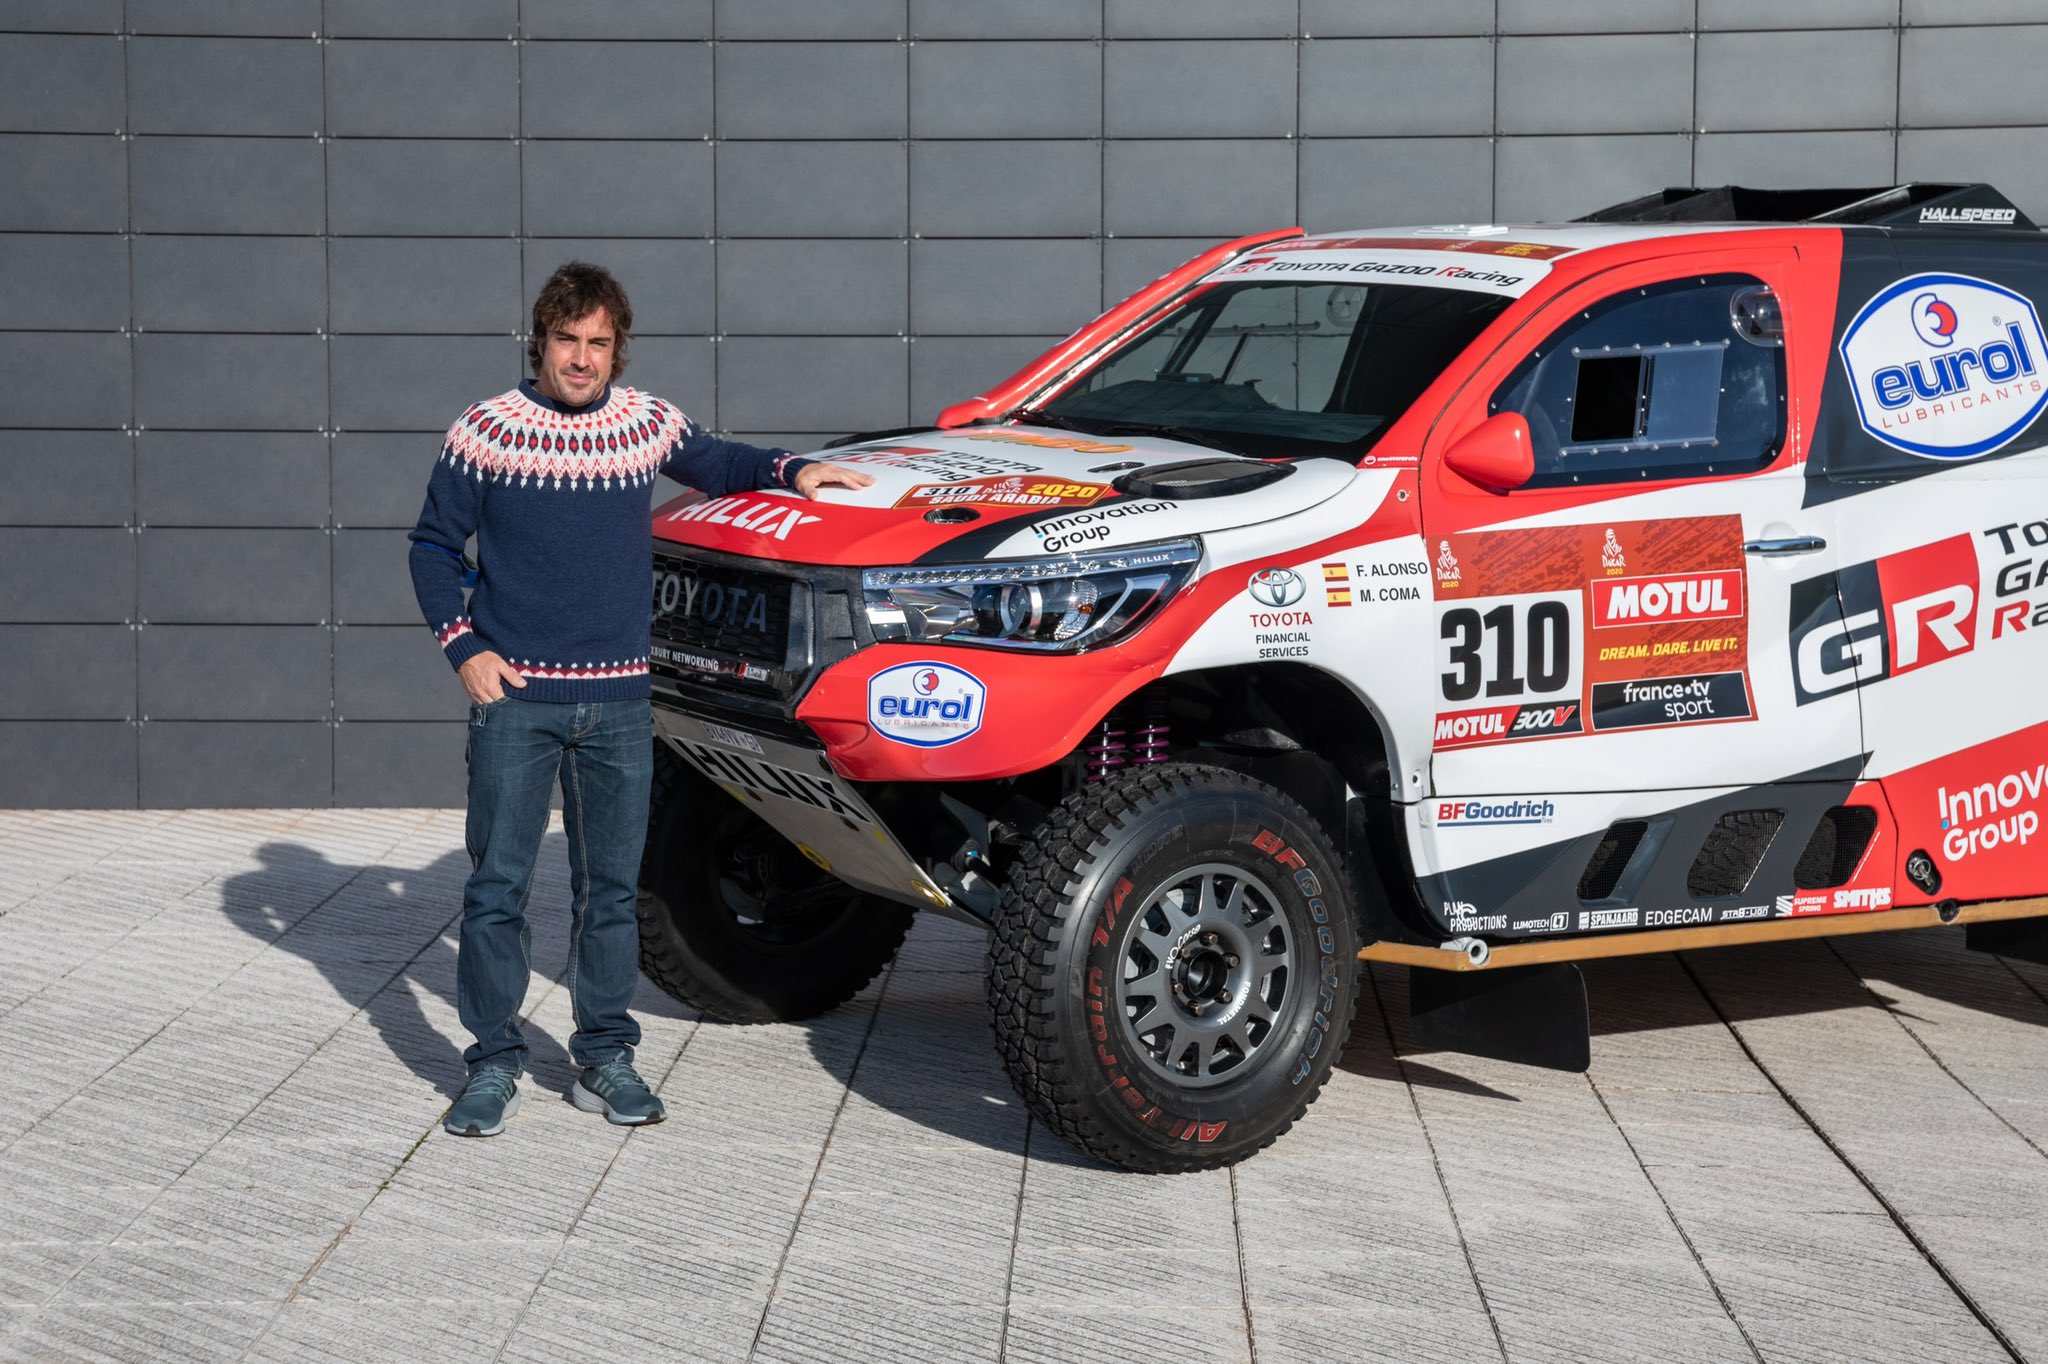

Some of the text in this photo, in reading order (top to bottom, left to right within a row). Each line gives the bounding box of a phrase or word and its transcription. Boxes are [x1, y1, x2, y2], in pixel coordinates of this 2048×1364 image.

[1919, 207, 2016, 223] HALLSPEED
[1267, 261, 1525, 287] TOYOTA GAZOO Racing
[1872, 321, 2037, 411] eurol
[1882, 380, 2042, 429] LUBRICANTS
[881, 458, 973, 482] Racing
[905, 455, 1005, 475] GAZOO
[937, 450, 1044, 473] TOYOTA
[924, 486, 971, 496] 310
[928, 493, 1061, 505] SAUDI ARABIA
[1026, 484, 1099, 498] 2020
[1029, 501, 1178, 538] Innovation
[1043, 525, 1111, 552] Group
[1132, 553, 1171, 565] HILUX
[1356, 561, 1428, 577] F. ALONSO
[1602, 554, 1626, 568] DAKAR
[1436, 566, 1462, 580] DAKAR
[1606, 567, 1623, 575] 2020
[1360, 586, 1420, 602] M. COMA
[1607, 578, 1729, 620] MOTUL
[1250, 611, 1313, 628] TOYOTA
[1255, 632, 1311, 645] FINANCIAL
[1798, 584, 1974, 694] GR
[1259, 646, 1309, 659] SERVICES
[1440, 600, 1571, 703] 310
[1599, 637, 1738, 661] DREAM. DARE. LIVE IT.
[672, 650, 719, 671] NETWORKING
[878, 693, 974, 721] eurol
[1664, 697, 1714, 722] sport
[1435, 705, 1577, 741] MOTUL 300V
[672, 737, 871, 823] HILUX
[1938, 764, 2048, 829] Innov
[1438, 800, 1555, 820] BFGoodrich
[1943, 810, 2039, 862] Group
[1444, 901, 1463, 916] PLAN
[1794, 896, 1827, 905] SUPREME
[1798, 904, 1822, 912] SPRING
[1833, 888, 1891, 910] SMITHS
[1450, 915, 1508, 933] PRODUCTIONS
[1513, 917, 1550, 930] LUMOTECH
[1590, 911, 1638, 926] SPANJAARD
[1645, 908, 1713, 926] EDGECAM
[1251, 829, 1338, 1086] BFGoodrich
[1217, 981, 1252, 1025] FONDMETAL
